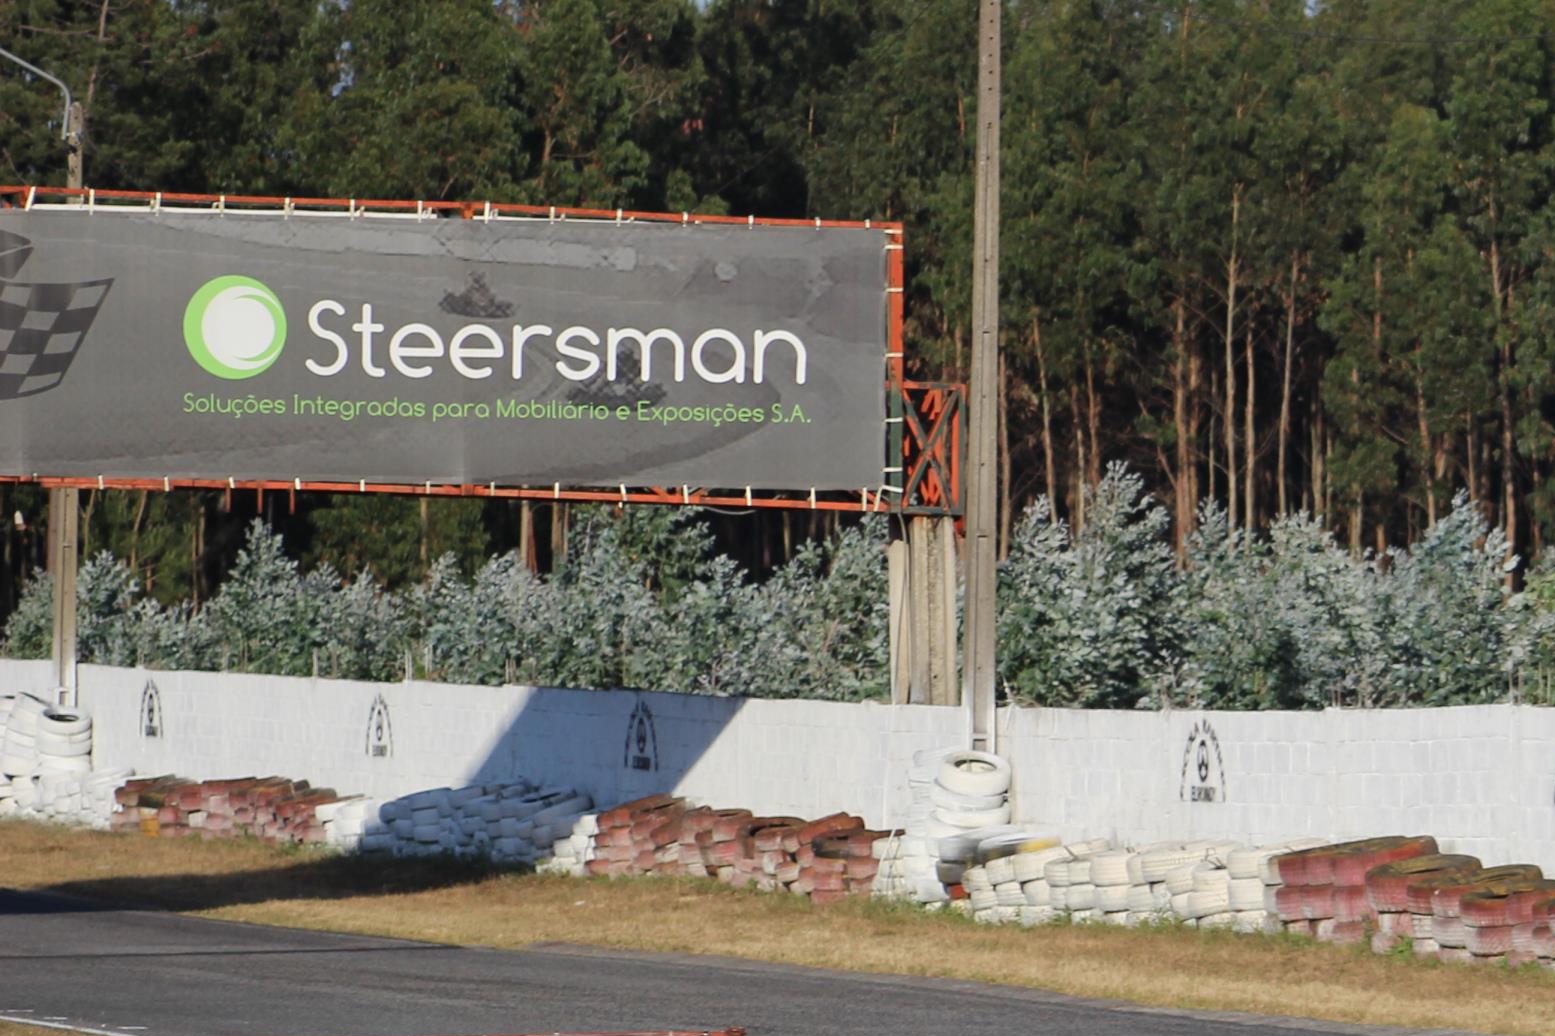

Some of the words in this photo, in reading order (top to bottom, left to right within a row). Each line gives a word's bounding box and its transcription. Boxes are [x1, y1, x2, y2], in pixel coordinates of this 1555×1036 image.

[305, 299, 807, 384] Steersman
[183, 392, 286, 418] Soluções
[293, 394, 426, 421] Integradas
[432, 400, 490, 422] para
[496, 398, 609, 421] Mobiliário
[616, 404, 631, 421] e
[637, 400, 764, 427] Exposições
[771, 403, 811, 424] S.A.
